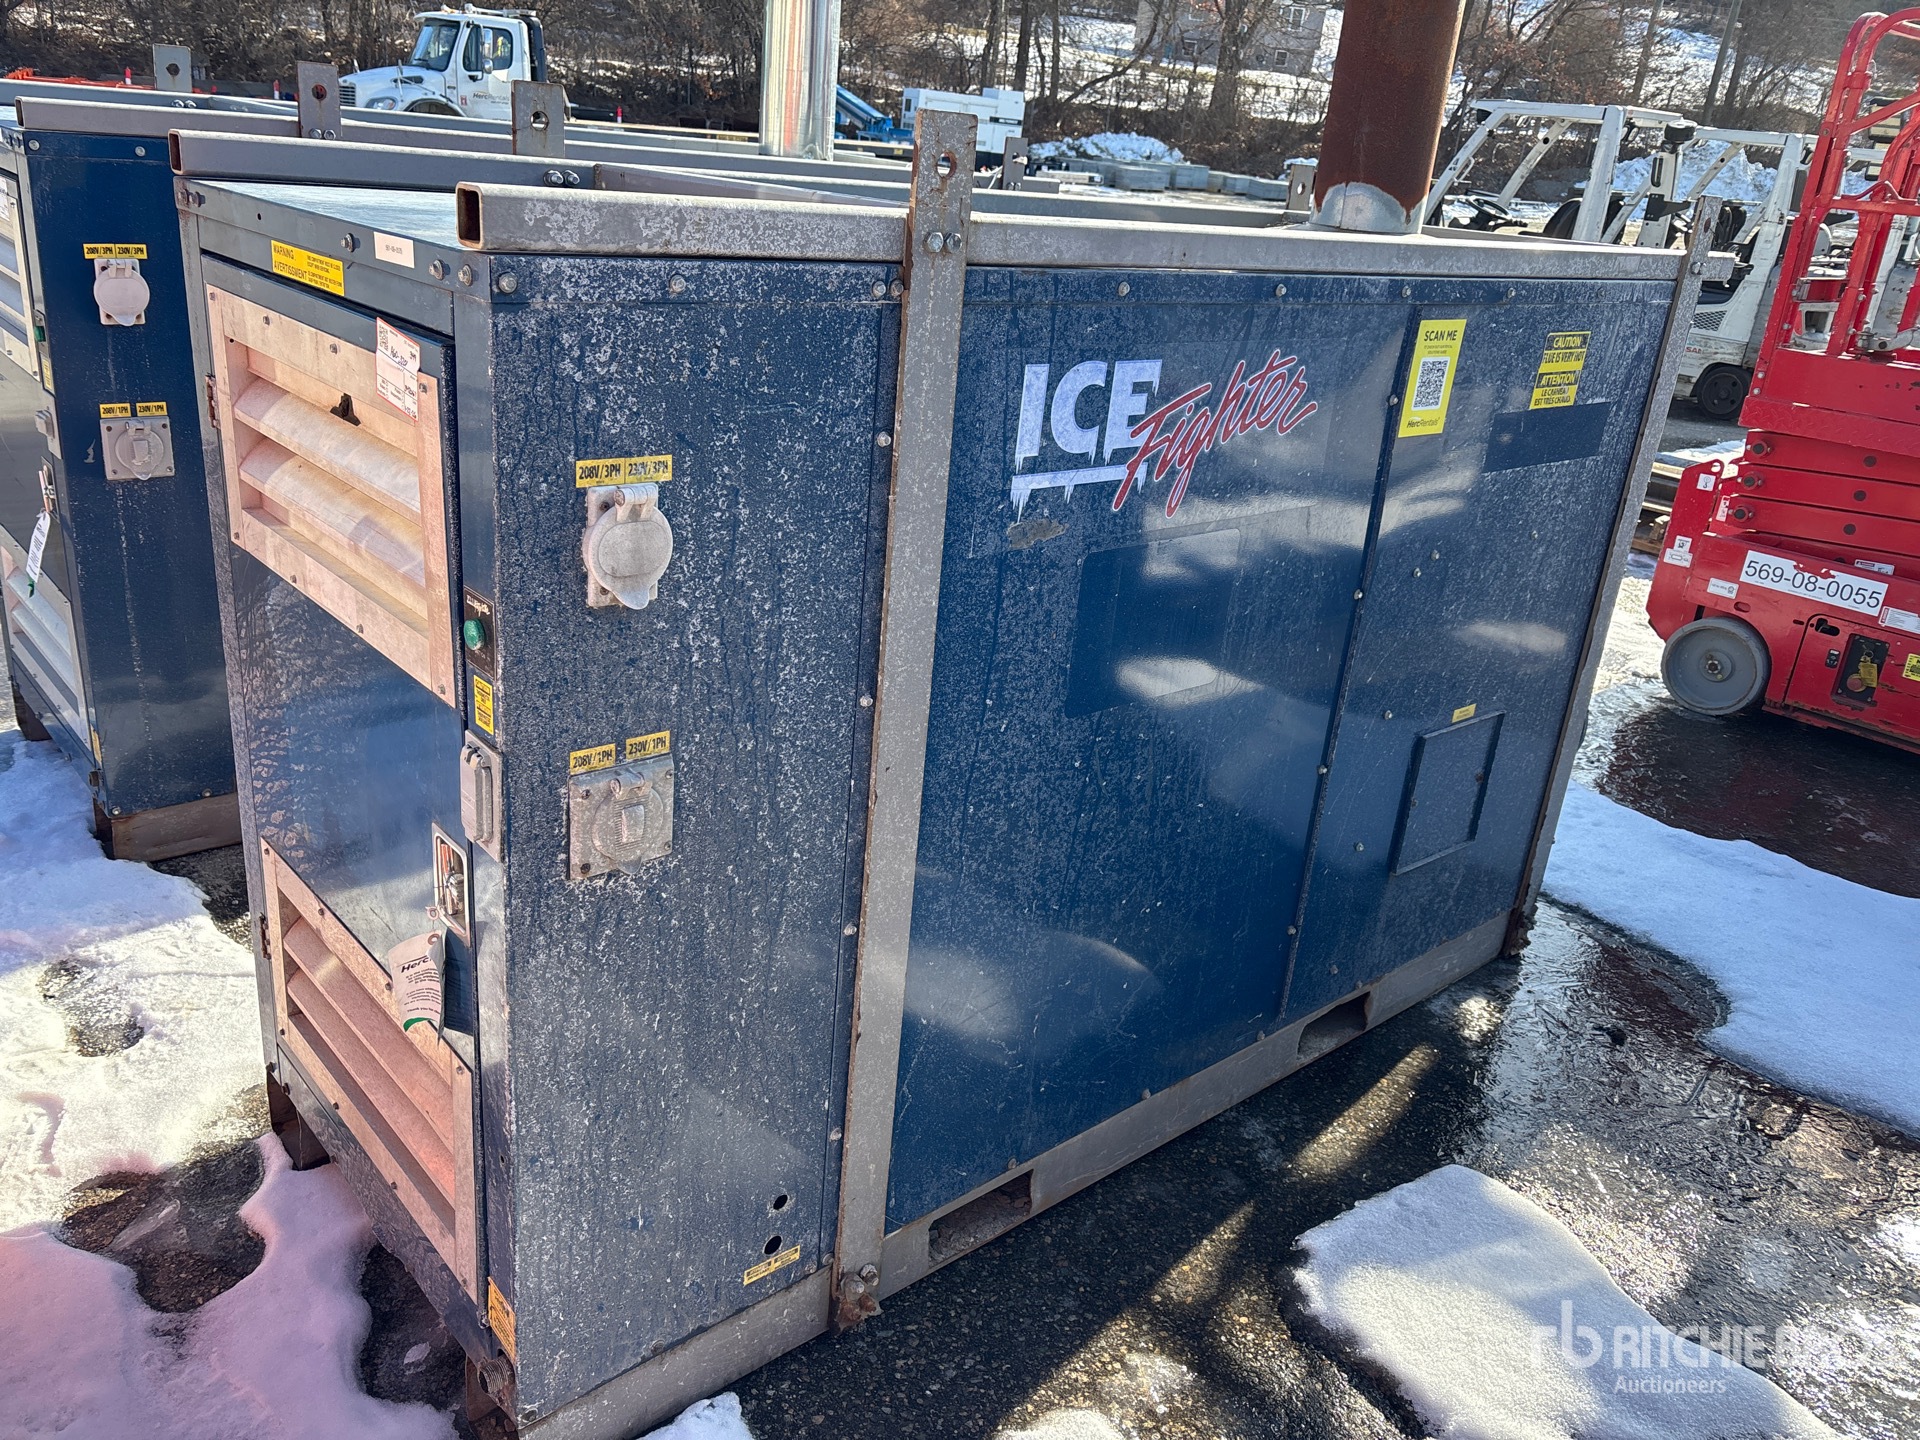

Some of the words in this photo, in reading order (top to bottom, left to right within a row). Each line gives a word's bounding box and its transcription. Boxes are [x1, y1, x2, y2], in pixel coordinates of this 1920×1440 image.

[117, 246, 144, 255] 230V/3PH
[1423, 330, 1446, 342] SCAN
[1446, 330, 1458, 341] ME
[1553, 336, 1582, 348] CAUTION
[1014, 358, 1163, 468] ICE
[1111, 349, 1318, 519] Fighter
[578, 463, 621, 480] 208V/3PH
[1744, 560, 1883, 609] 569-08-0055
[629, 736, 667, 755] 230V/1PH
[573, 749, 613, 769] 208V/1PH
[401, 957, 432, 973] Herc
